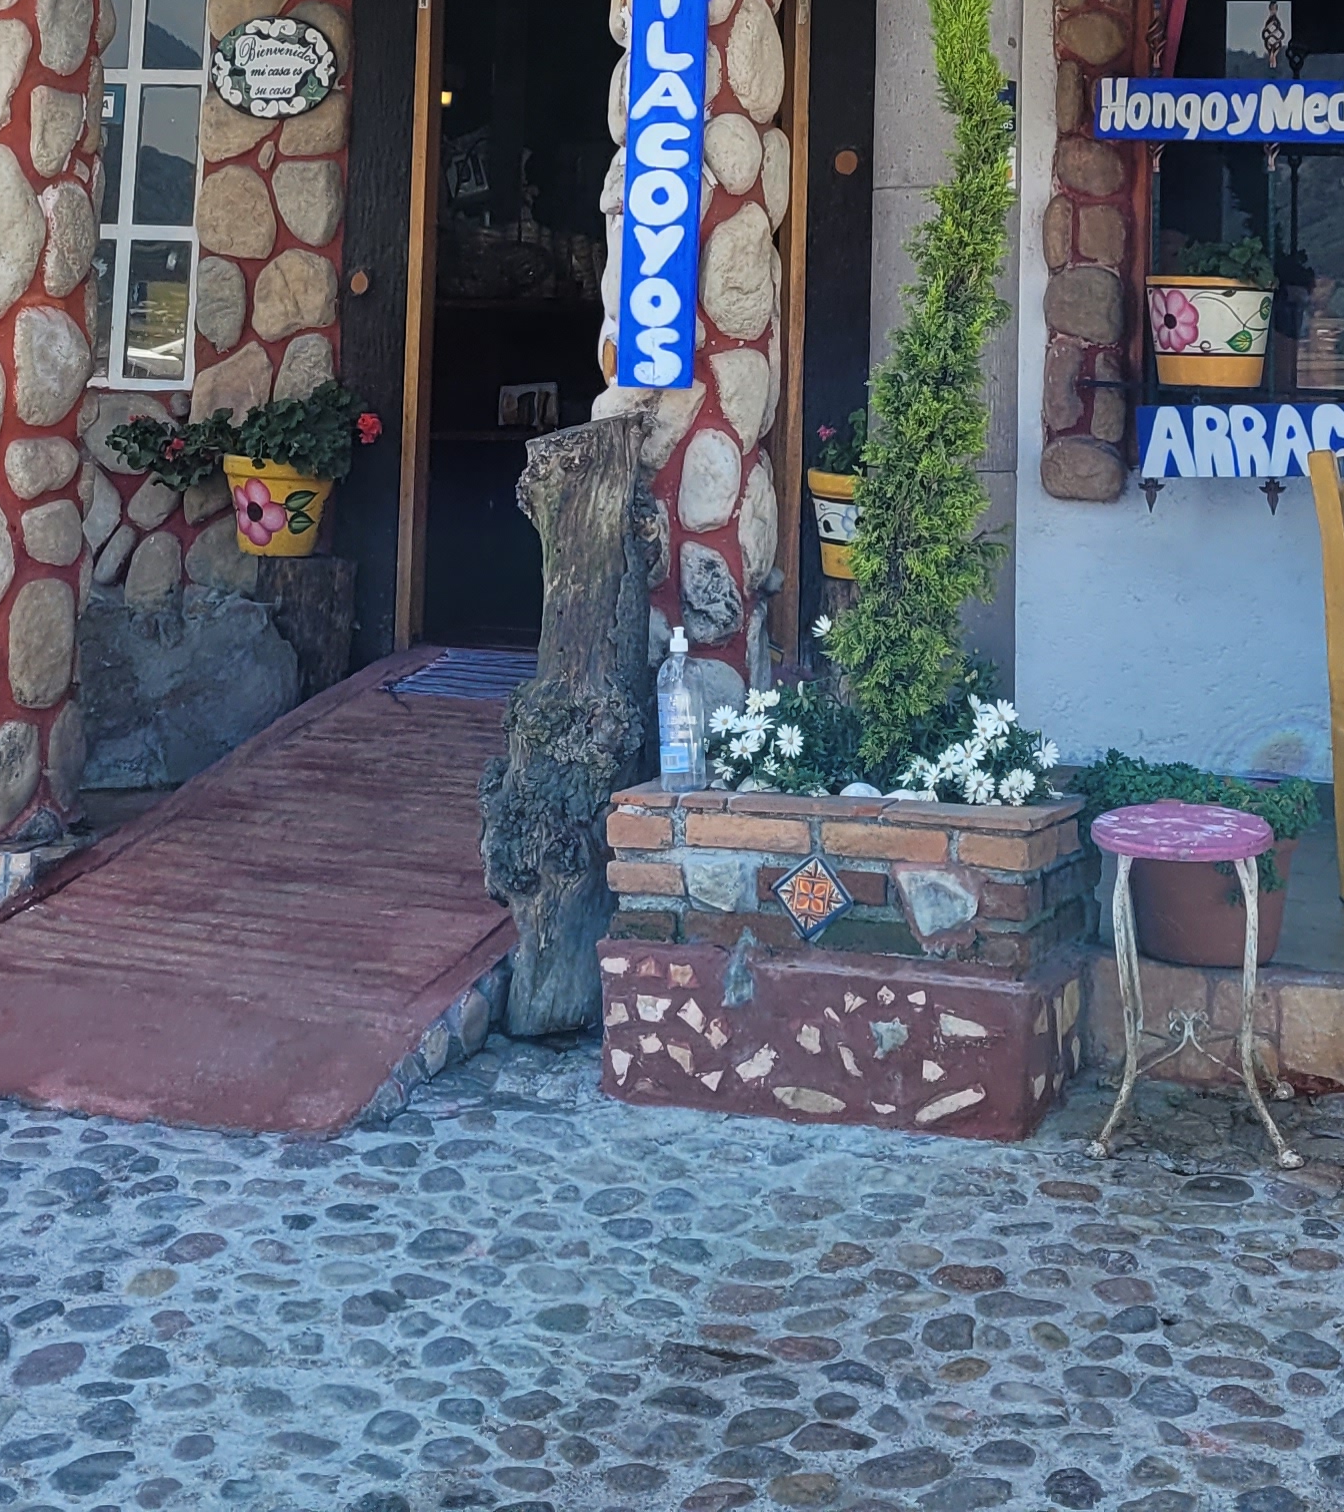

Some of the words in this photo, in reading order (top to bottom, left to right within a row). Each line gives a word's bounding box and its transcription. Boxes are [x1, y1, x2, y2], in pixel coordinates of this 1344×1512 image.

[239, 38, 316, 66] Bienvenidos
[250, 64, 268, 77] mi
[270, 67, 291, 76] casa
[293, 66, 303, 76] es
[255, 87, 267, 96] su
[269, 85, 292, 96] casa
